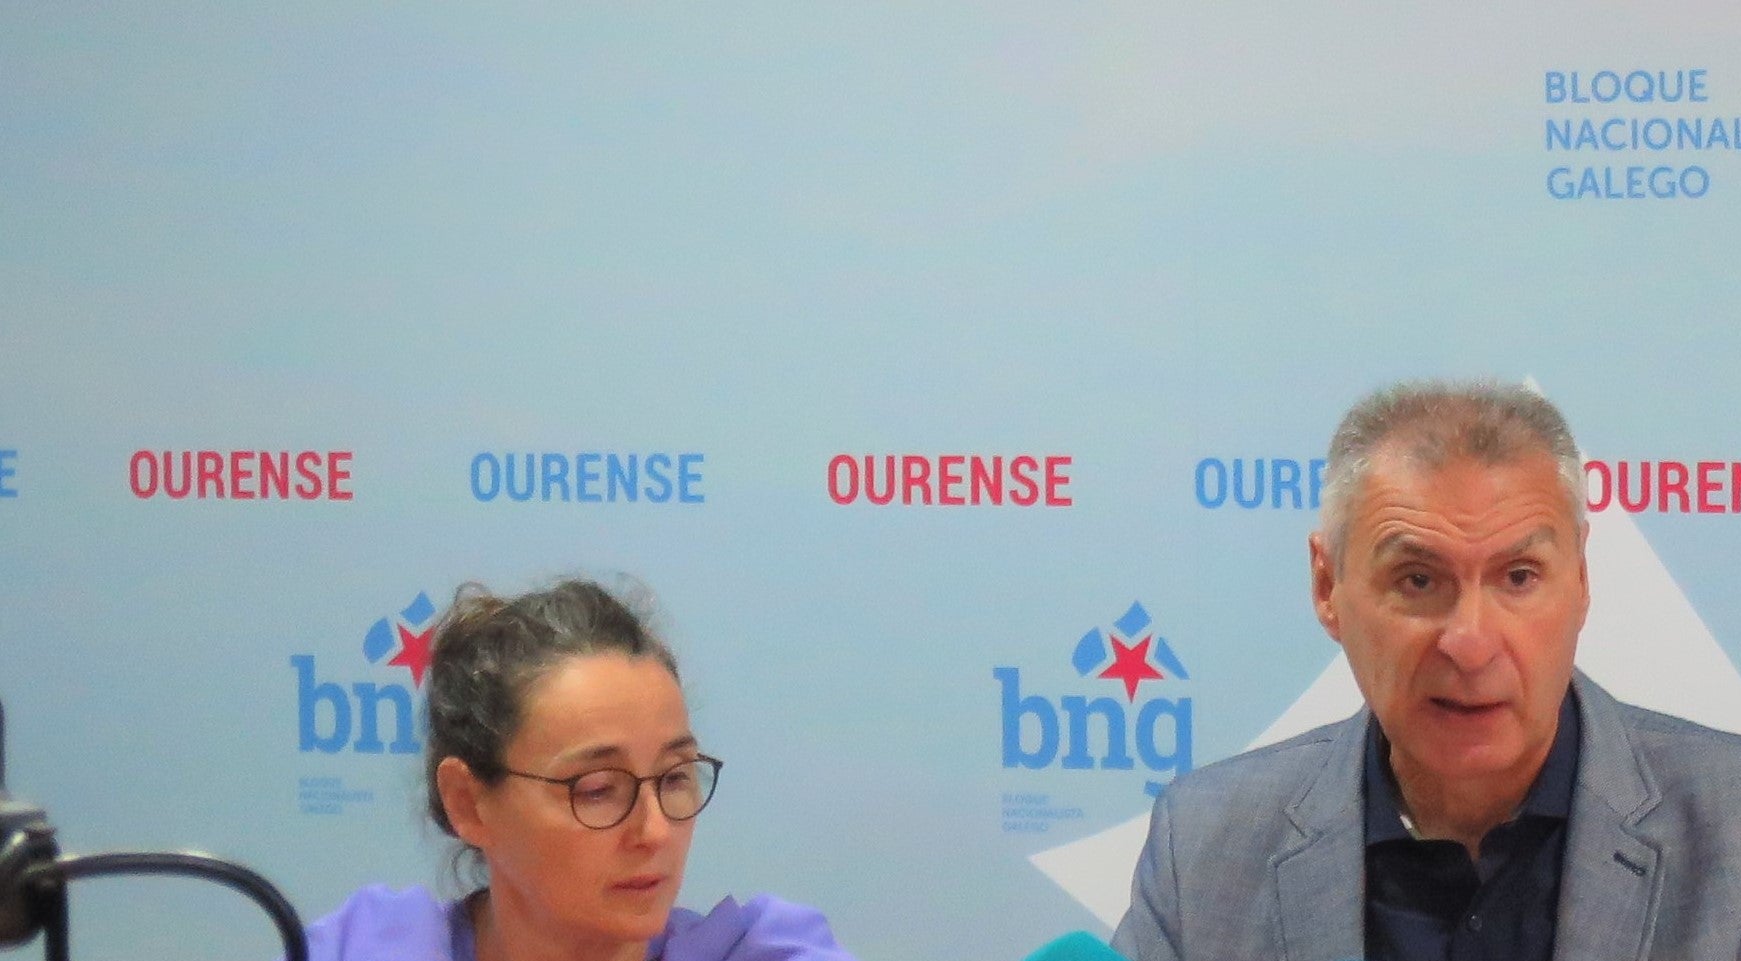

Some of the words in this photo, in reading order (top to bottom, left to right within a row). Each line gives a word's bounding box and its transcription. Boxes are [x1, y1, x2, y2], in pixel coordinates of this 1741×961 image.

[1545, 69, 1709, 104] BLOQUE
[1547, 165, 1711, 200] GALEGO
[130, 450, 352, 500] OURENSE
[470, 452, 706, 504] OURENSE
[828, 454, 1072, 506] OURENSE
[291, 655, 420, 754] bn
[993, 667, 1193, 798] bng
